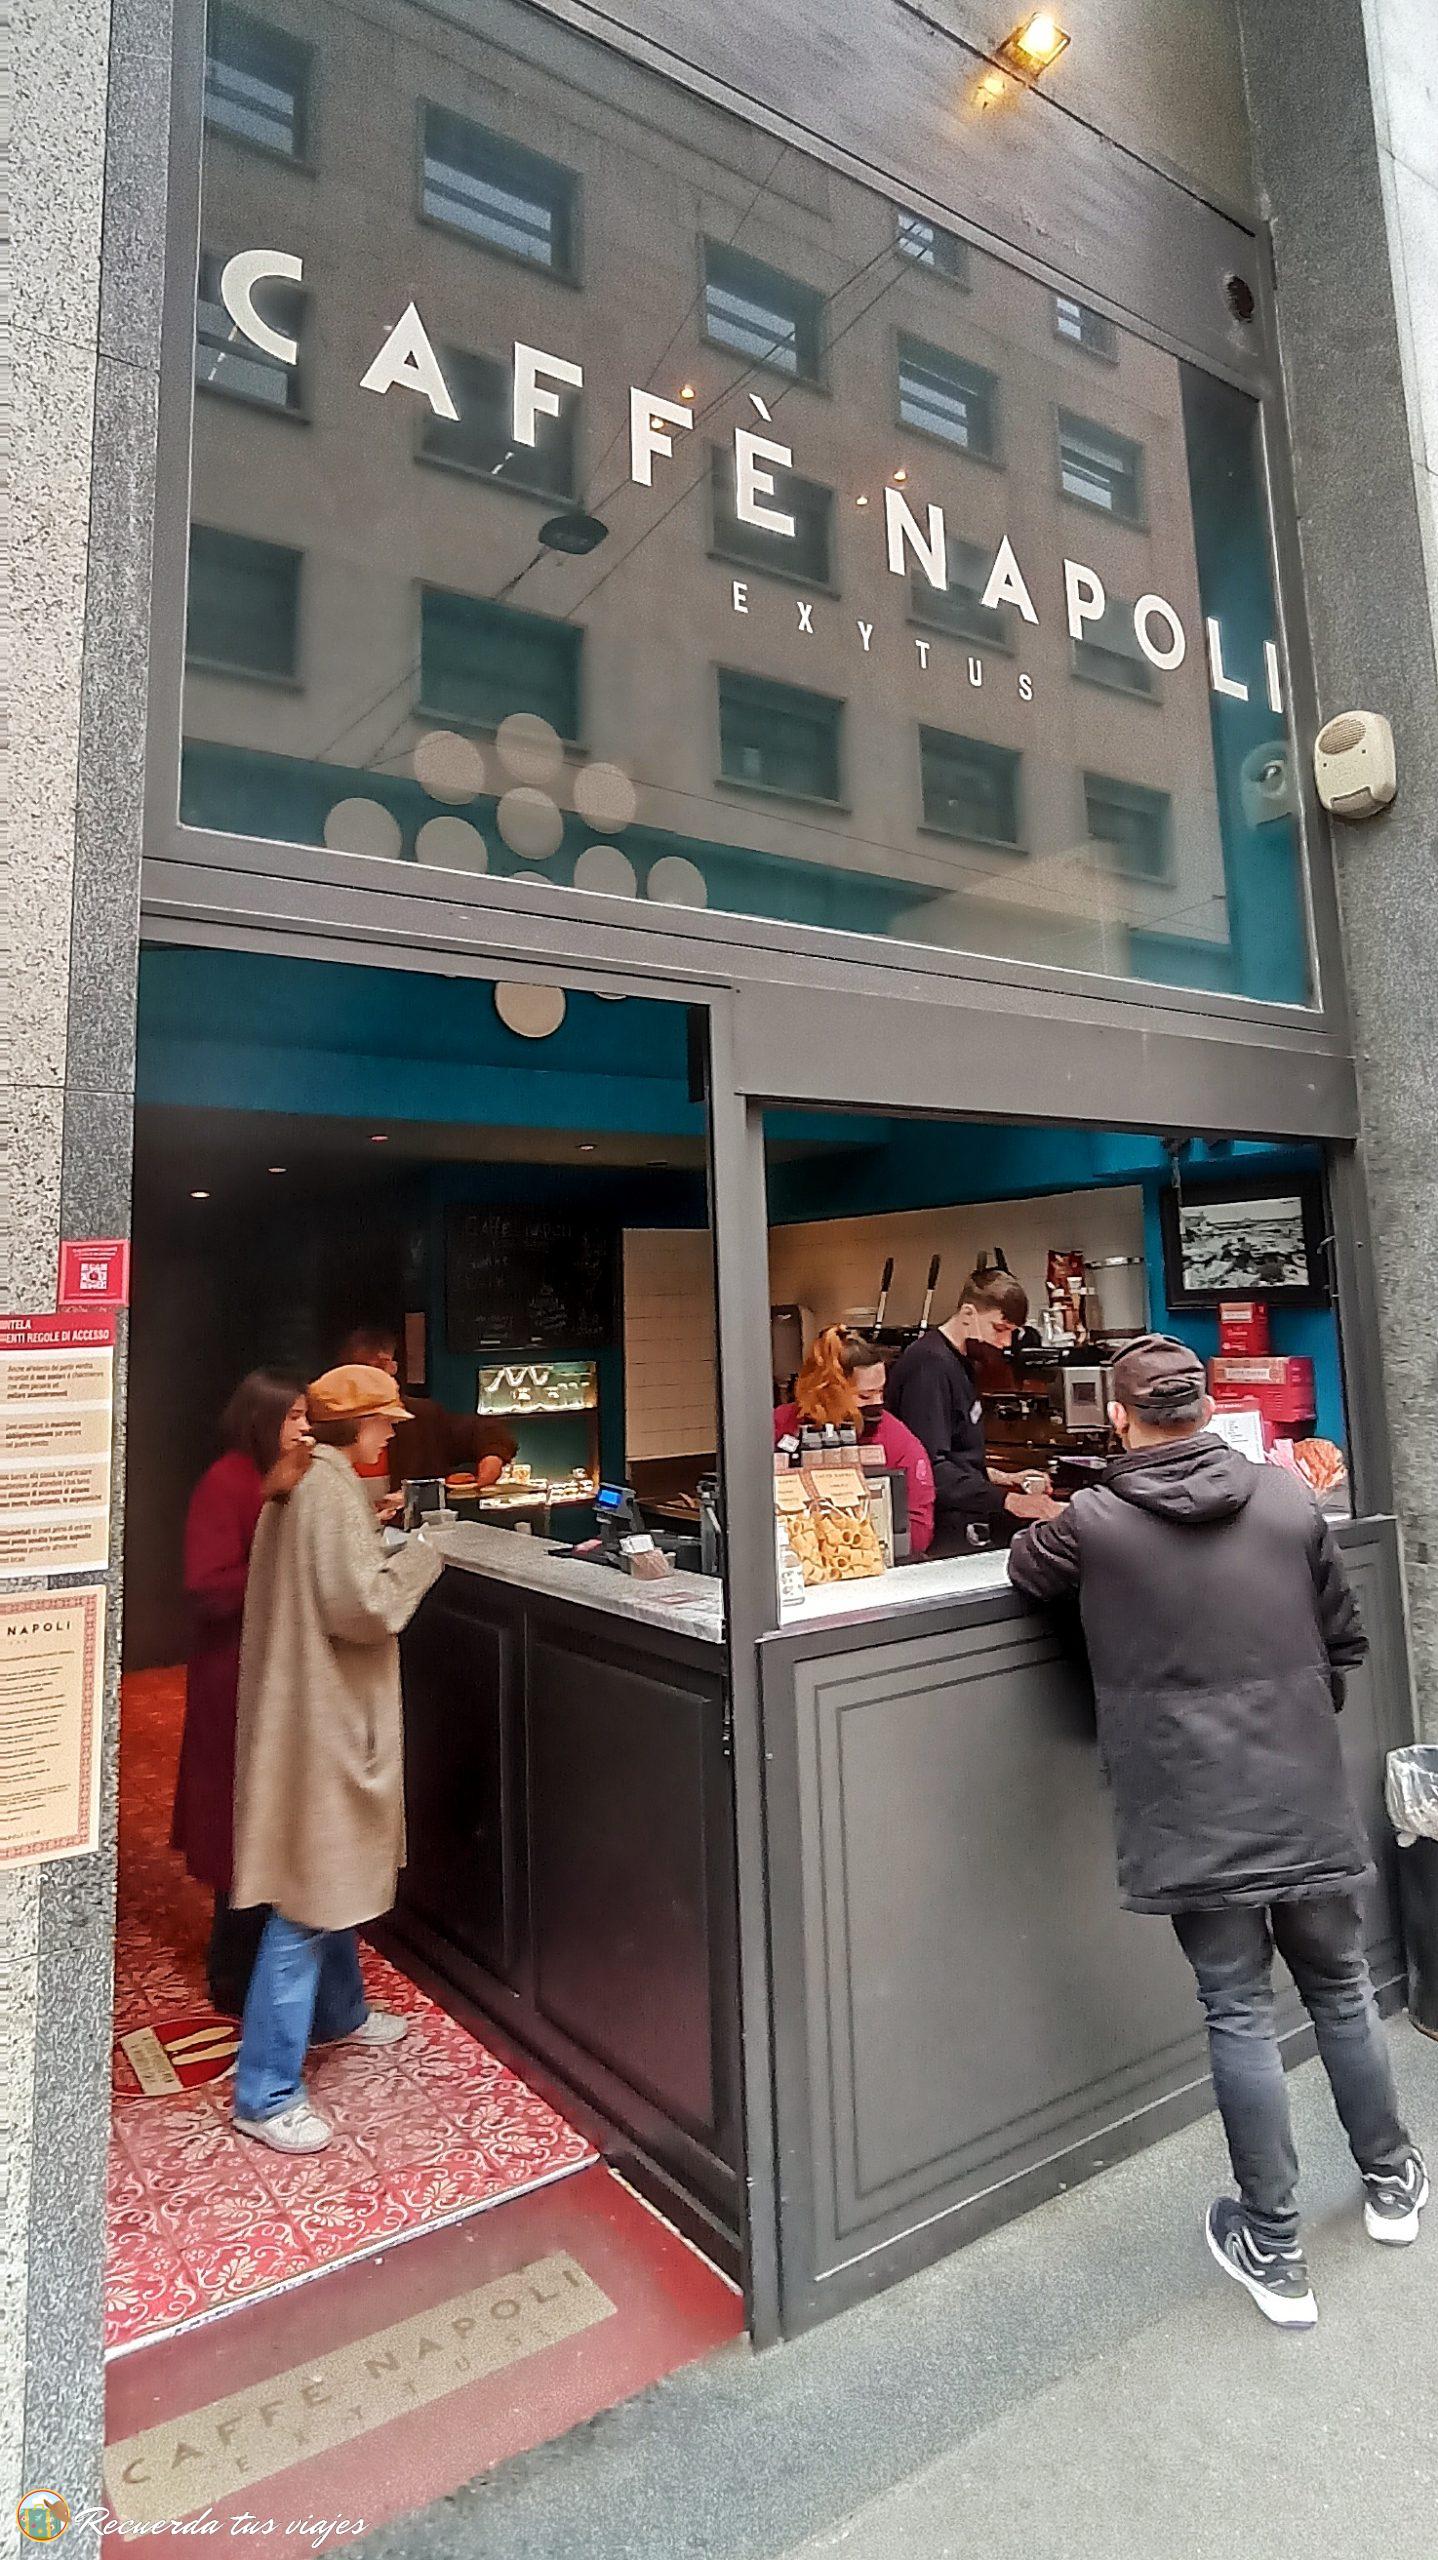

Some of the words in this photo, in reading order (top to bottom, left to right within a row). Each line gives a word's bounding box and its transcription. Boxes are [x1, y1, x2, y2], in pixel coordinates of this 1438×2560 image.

[221, 249, 796, 537] CAFFÈ
[884, 487, 1285, 714] NAPOLI
[732, 581, 1034, 701] EXYTUS
[27, 1331, 60, 1343] REGOLE
[61, 1331, 71, 1342] DI
[72, 1329, 110, 1341] ACCESSO
[7, 1620, 71, 1636] NAPOLI
[364, 2269, 584, 2382] NAPOLI
